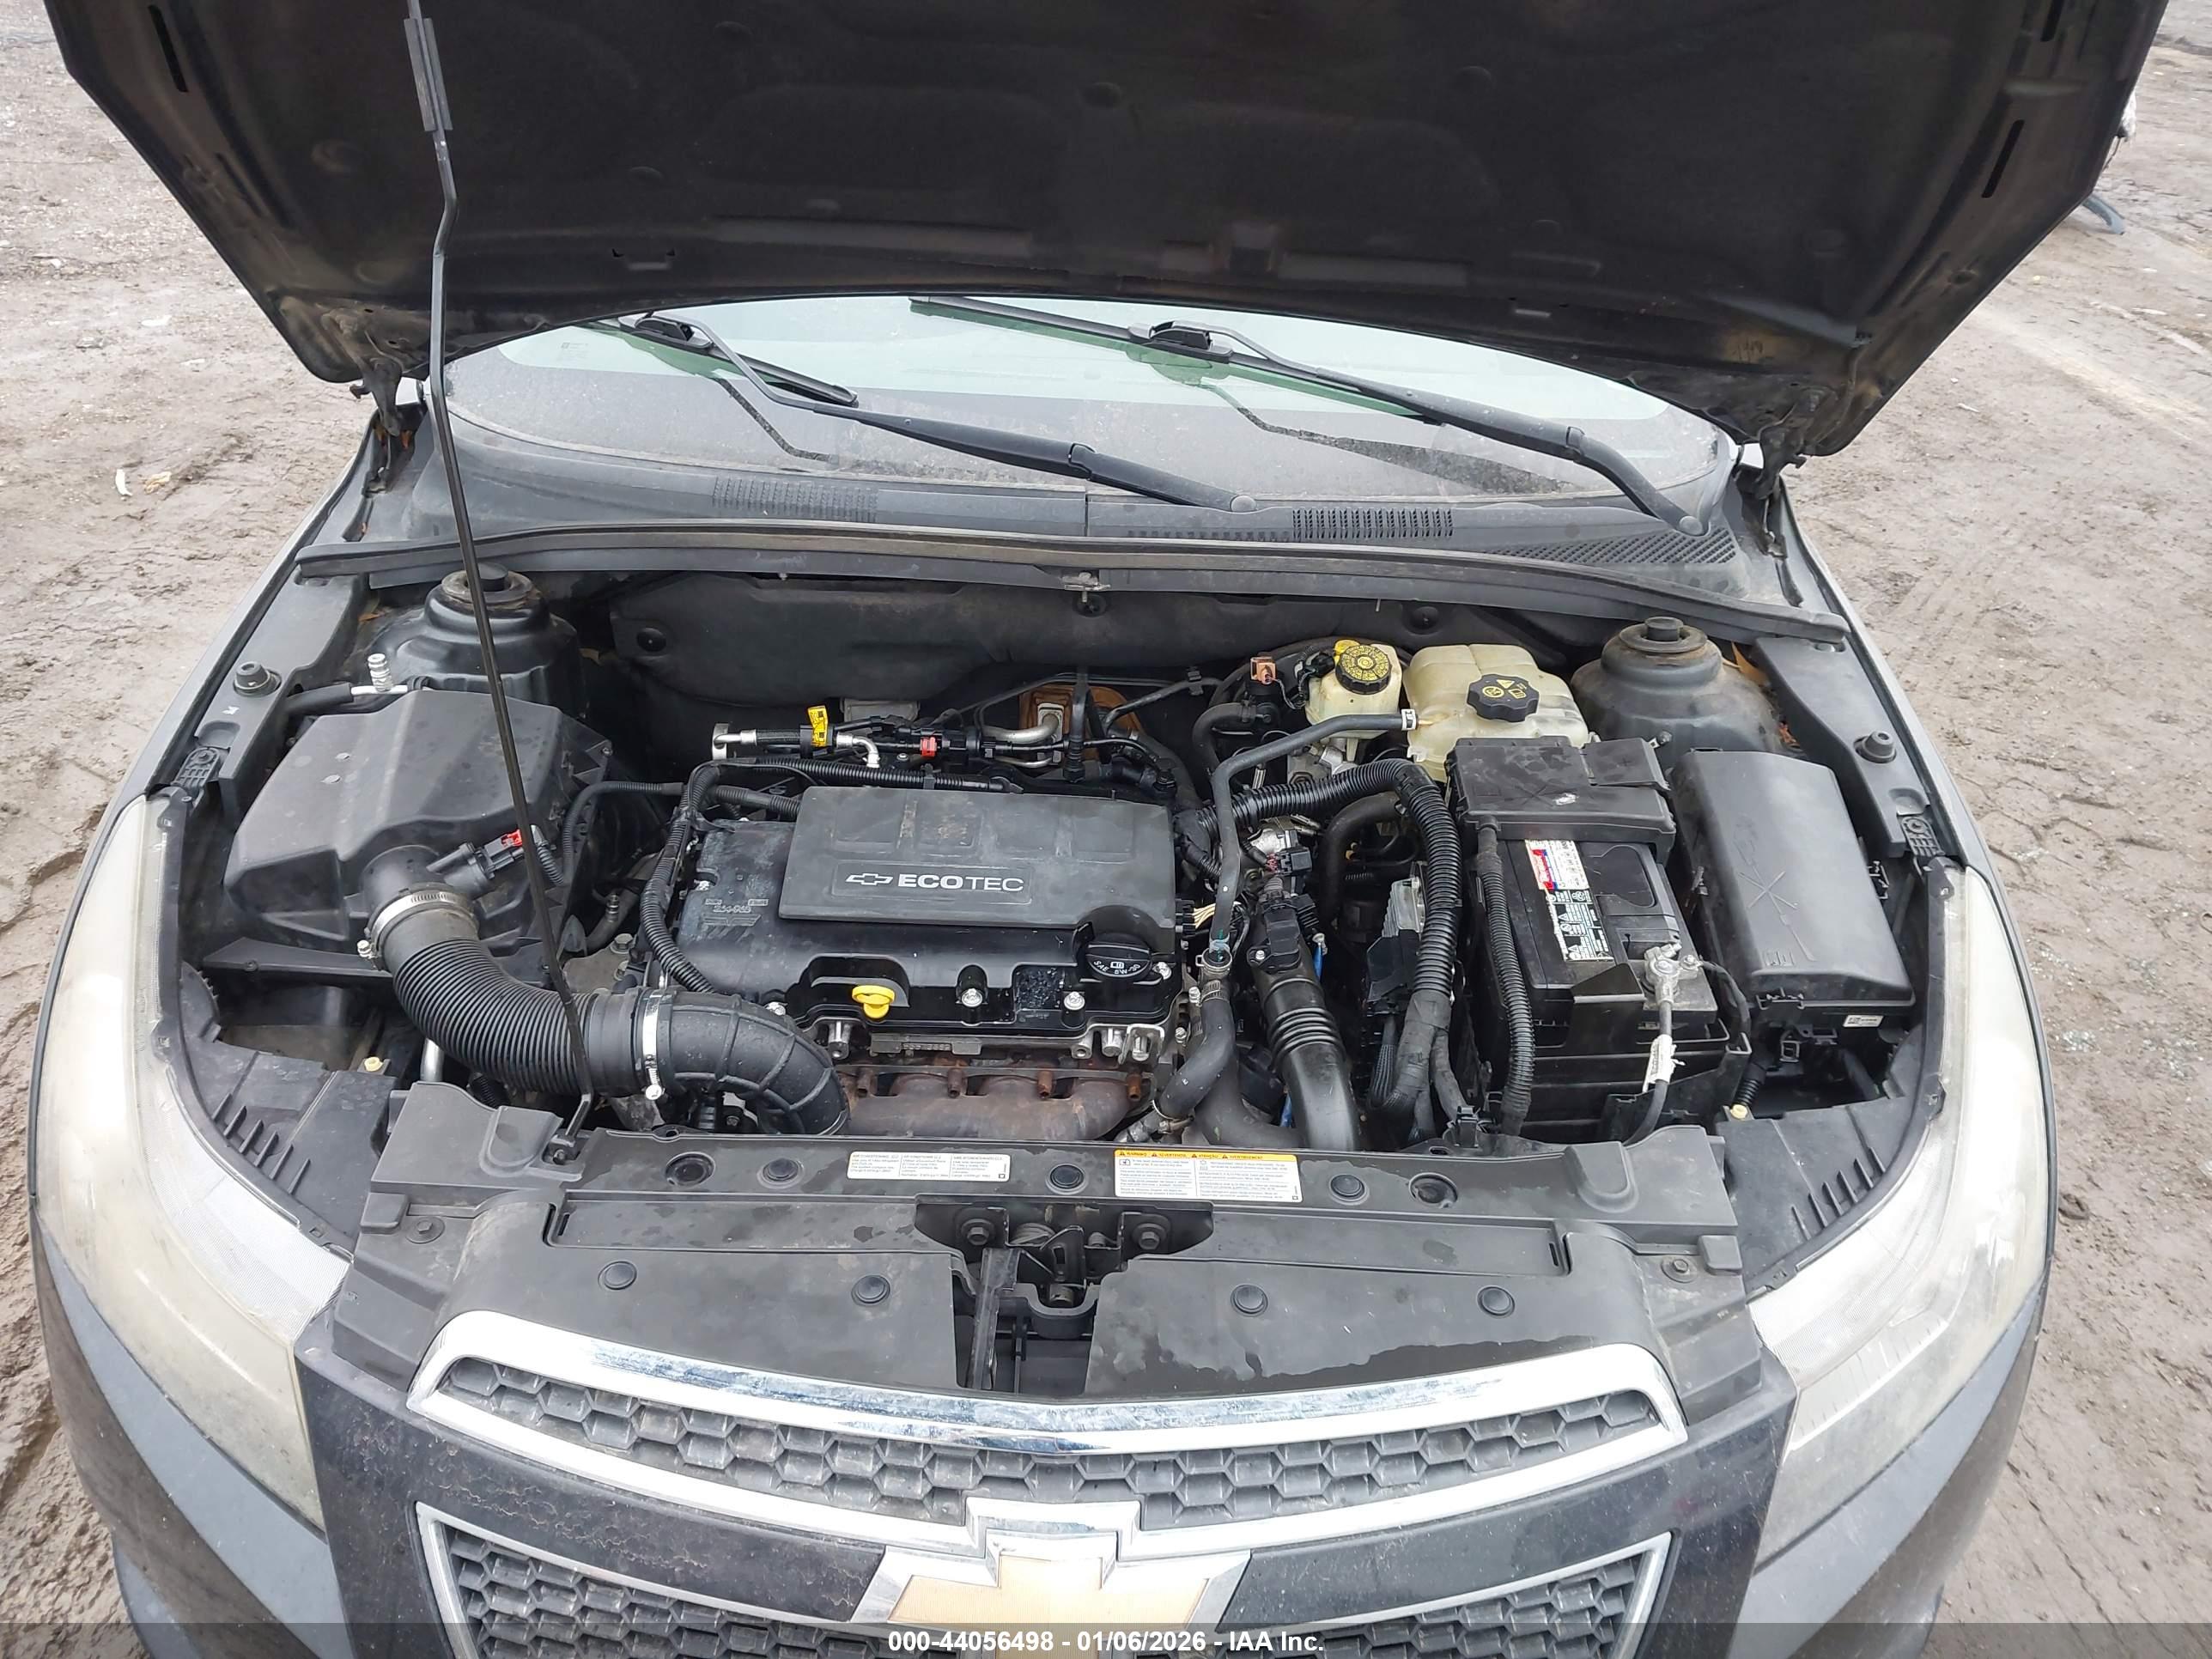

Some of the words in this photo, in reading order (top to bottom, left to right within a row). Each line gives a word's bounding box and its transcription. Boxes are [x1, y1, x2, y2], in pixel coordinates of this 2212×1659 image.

[897, 873, 1024, 892] ECOTEC
[1093, 960, 1110, 972] SAE
[1114, 963, 1141, 975] 5W-30
